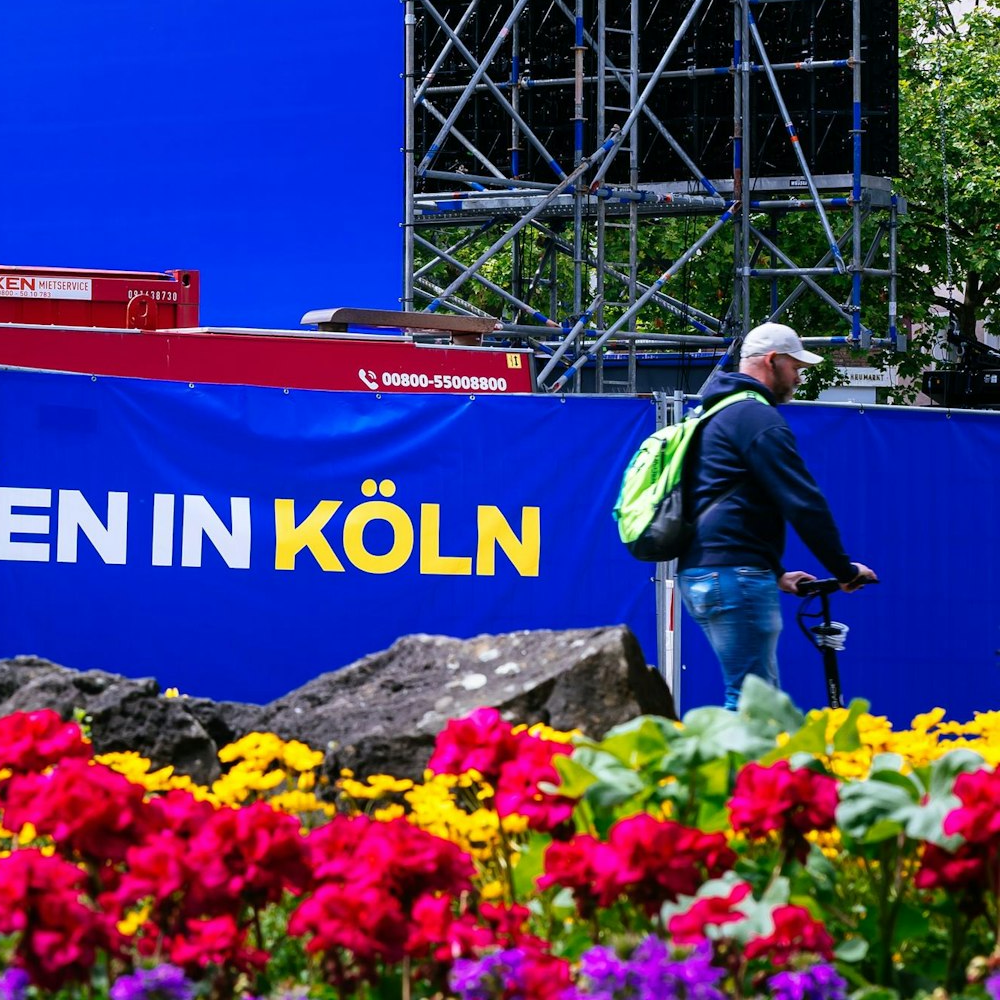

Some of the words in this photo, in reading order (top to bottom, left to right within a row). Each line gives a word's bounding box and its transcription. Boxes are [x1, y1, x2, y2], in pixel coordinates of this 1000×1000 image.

[38, 281, 89, 291] MIETSERVICE
[381, 371, 508, 392] 00800-55008800
[151, 493, 252, 569] IN
[274, 478, 541, 577] KÖLN
